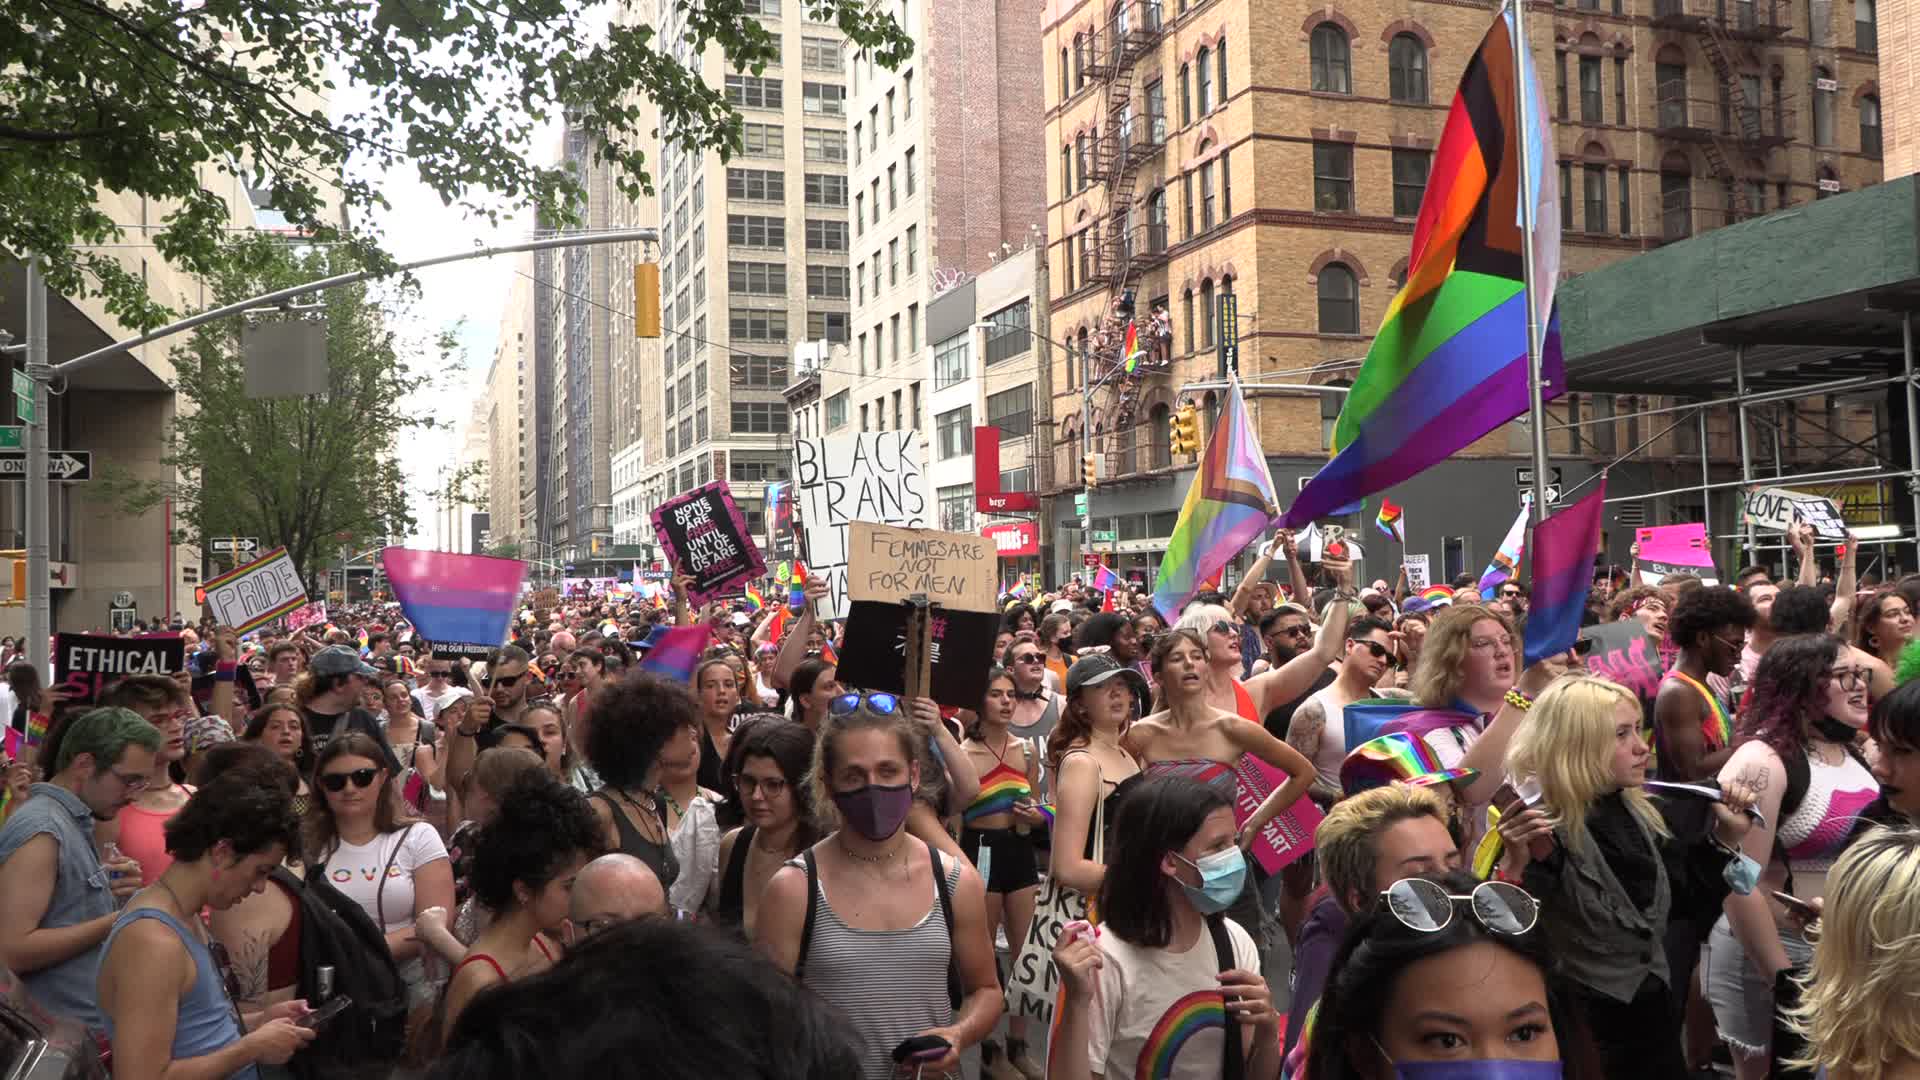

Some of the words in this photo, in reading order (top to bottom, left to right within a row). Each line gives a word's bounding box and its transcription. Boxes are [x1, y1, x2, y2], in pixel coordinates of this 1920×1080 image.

[3, 460, 24, 472] ON
[796, 431, 920, 485] BLACK
[674, 496, 709, 518] NONE
[800, 473, 924, 526] TRANS
[1747, 492, 1789, 522] LOVE
[676, 512, 692, 526] OF
[694, 503, 712, 517] US
[687, 513, 710, 531] ARE
[686, 528, 724, 552] UNTIL
[688, 520, 716, 541] FREE
[691, 546, 713, 563] ALL
[714, 534, 730, 550] OF
[692, 555, 711, 572] US
[714, 543, 738, 564] ARE
[947, 540, 984, 561] ARE
[899, 557, 945, 574] NOT
[1652, 563, 1699, 576] BLACK
[216, 561, 299, 627] PRIDE
[869, 570, 909, 592] FOR
[914, 573, 966, 595] MEN
[433, 644, 448, 652] FOR
[68, 646, 173, 674] ETHICAL
